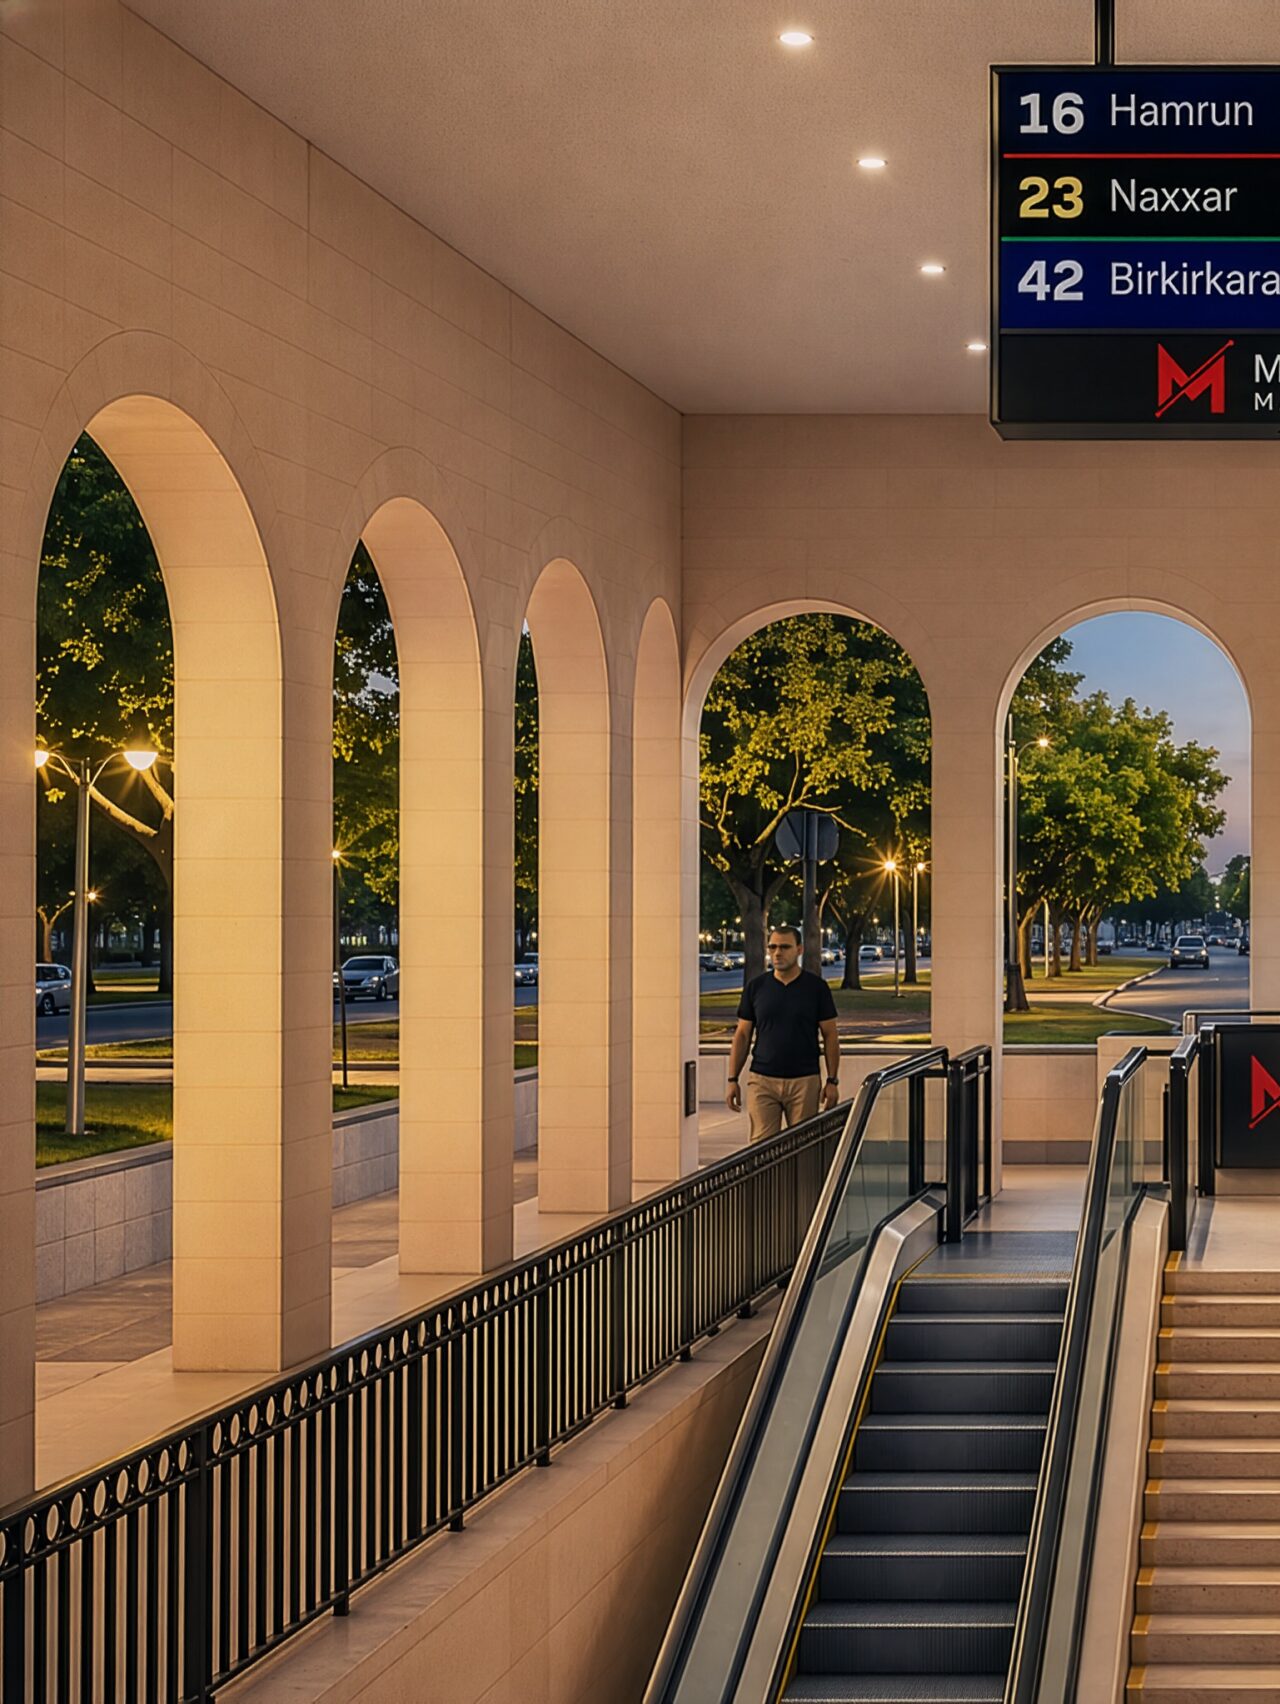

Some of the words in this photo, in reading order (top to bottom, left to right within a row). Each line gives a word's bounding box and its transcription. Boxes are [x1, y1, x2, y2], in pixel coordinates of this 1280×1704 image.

[1019, 92, 1085, 135] 16
[1111, 93, 1253, 127] Hamrun
[1019, 176, 1084, 219] 23
[1111, 178, 1238, 212] Naxxar
[1017, 259, 1084, 301] 42
[1111, 260, 1280, 296] Birkirkara
